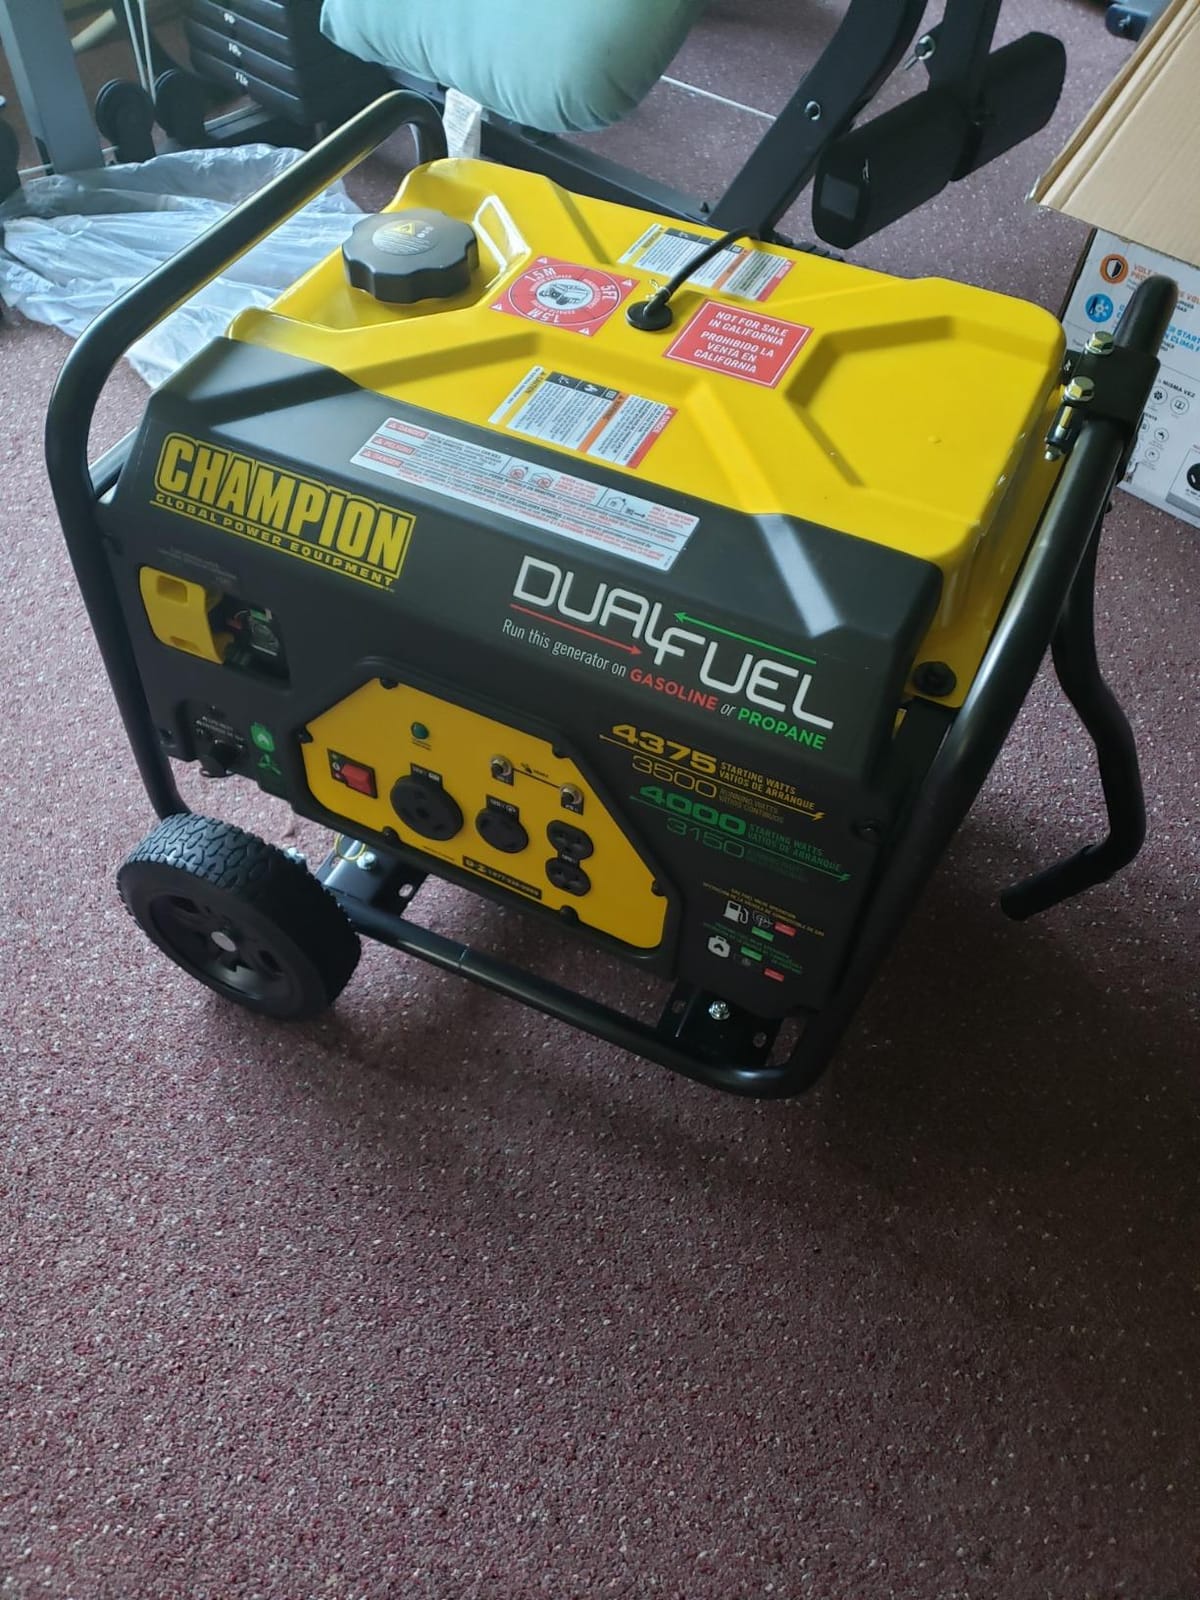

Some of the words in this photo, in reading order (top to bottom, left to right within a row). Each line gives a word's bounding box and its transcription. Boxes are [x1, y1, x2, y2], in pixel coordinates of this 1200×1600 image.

[700, 331, 760, 352] PROHIBIDO
[760, 347, 775, 358] LA
[708, 319, 722, 328] IN
[722, 322, 784, 346] CALIFORNIA
[715, 311, 739, 322] NOT
[738, 316, 760, 329] FOR
[761, 324, 789, 338] SALE
[693, 349, 757, 374] CALIFORNIA
[707, 342, 741, 358] VENTA
[741, 353, 758, 364] EN
[157, 437, 412, 571] CHAMPION
[155, 494, 217, 524] GLOBAL
[222, 515, 282, 547] POWER
[289, 542, 395, 587] EQUIPMENT
[502, 618, 525, 640] Run
[528, 629, 550, 649] this
[552, 641, 609, 671] generator
[611, 662, 627, 678] on
[628, 667, 719, 711] GASOLINE
[720, 703, 737, 717] or
[737, 707, 827, 750] PROPANE
[611, 723, 718, 774] 4375
[632, 755, 718, 799] 3500
[719, 770, 749, 787] VATIOS
[751, 782, 764, 793] DE
[765, 787, 817, 811] ARRANQUE
[720, 761, 764, 783] STARTING
[766, 777, 797, 795] WATTS
[639, 785, 748, 836] 4000
[666, 817, 745, 859] 3150
